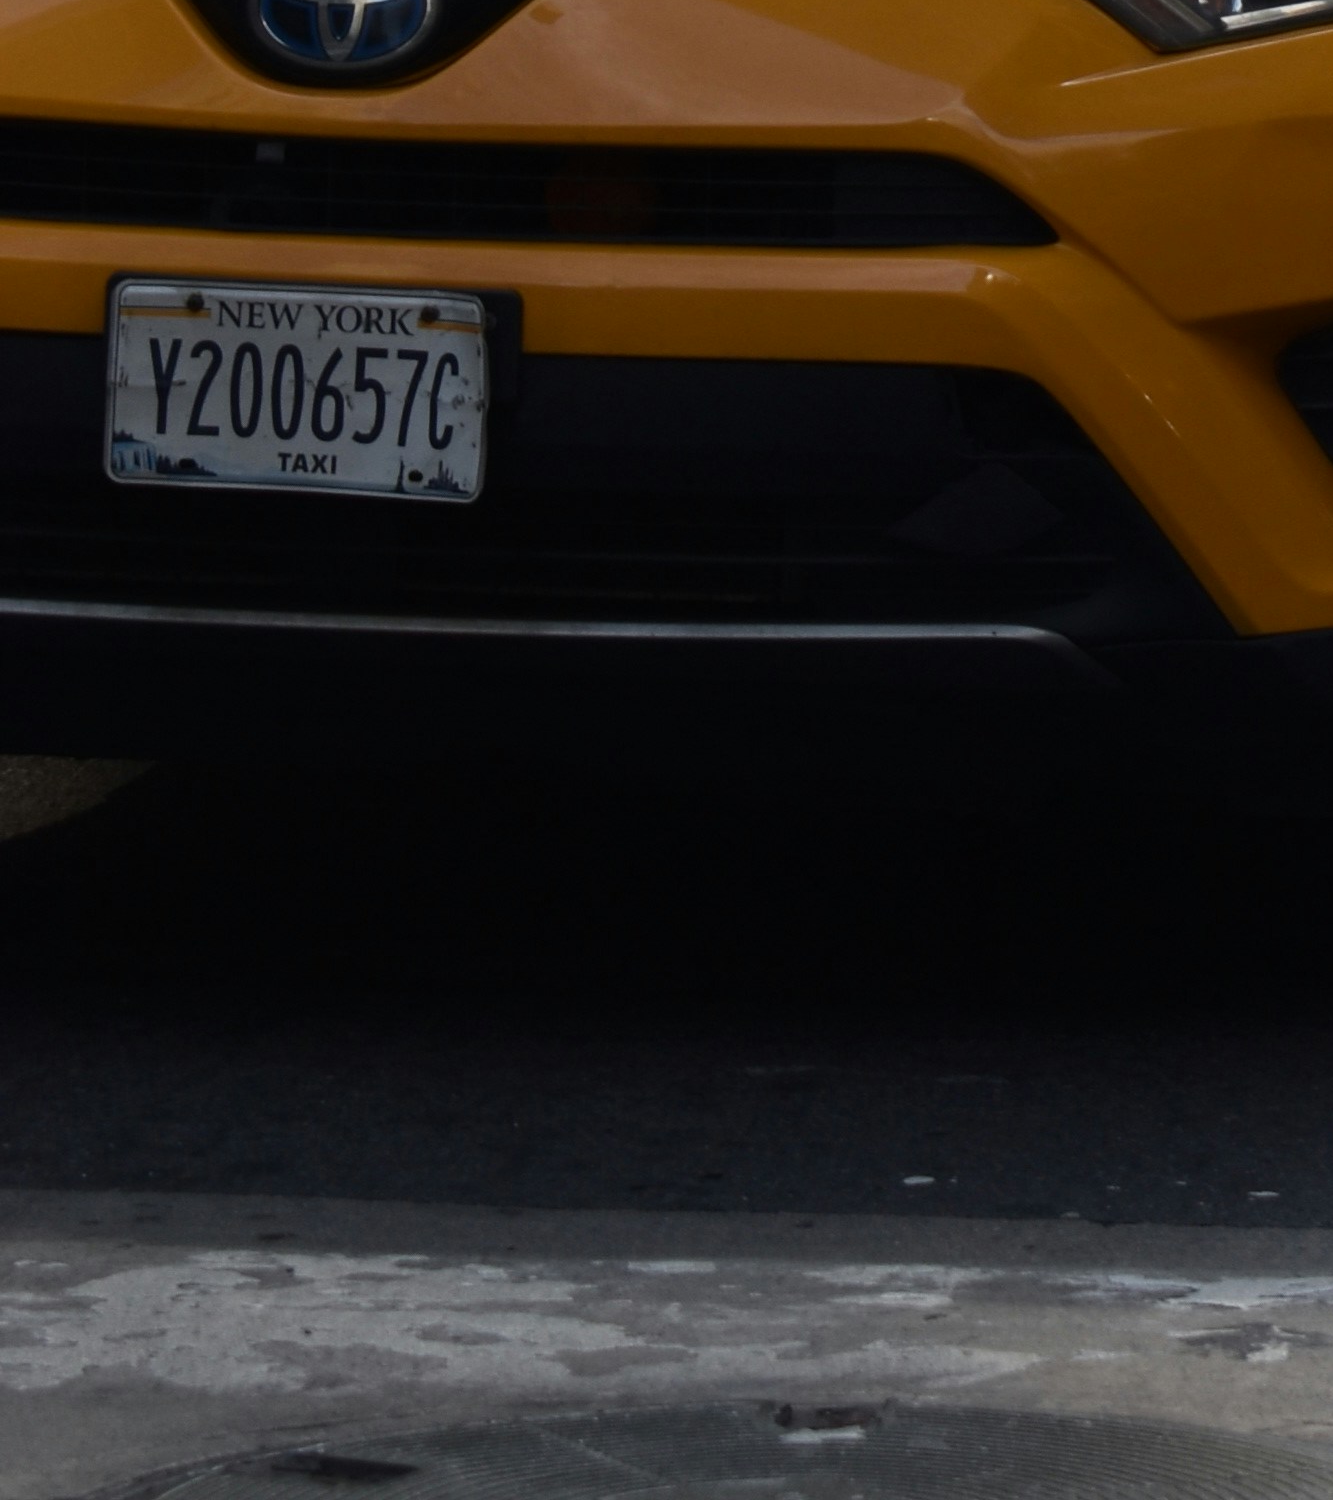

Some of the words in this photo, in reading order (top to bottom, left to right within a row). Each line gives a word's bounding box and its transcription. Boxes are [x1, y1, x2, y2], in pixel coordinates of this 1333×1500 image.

[216, 300, 304, 330] NEW
[314, 303, 414, 337] YORK
[149, 336, 460, 451] Y200657C
[277, 451, 338, 475] TAXI
